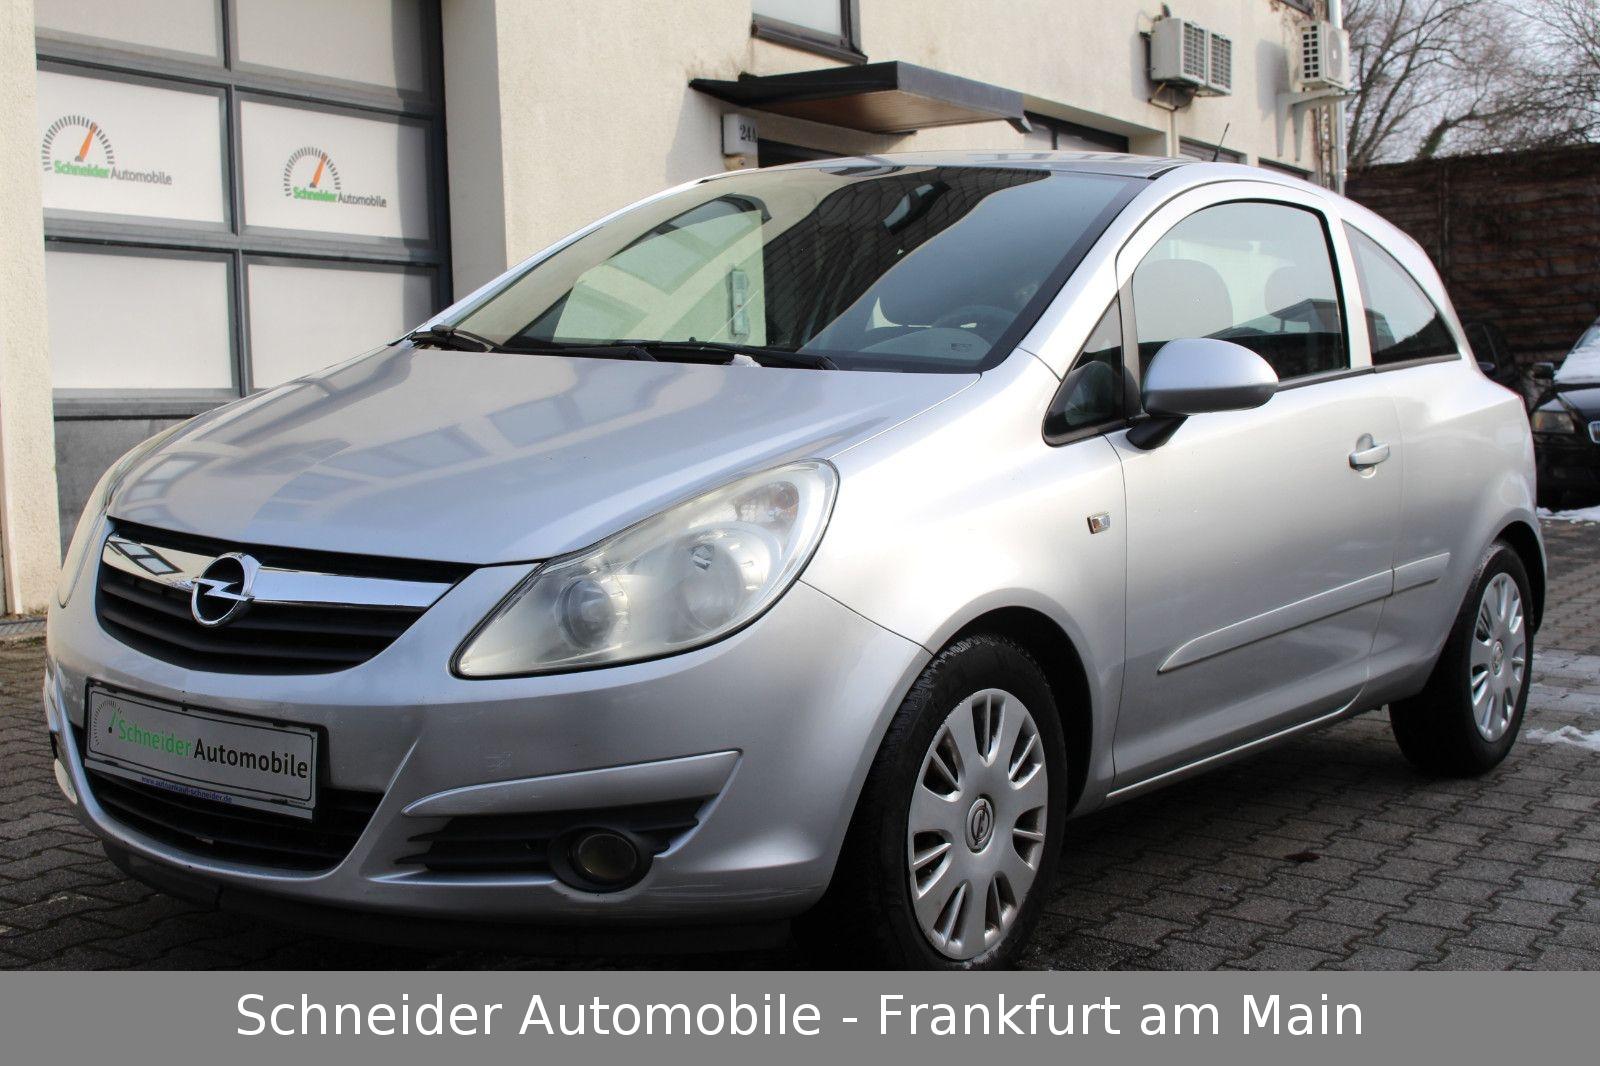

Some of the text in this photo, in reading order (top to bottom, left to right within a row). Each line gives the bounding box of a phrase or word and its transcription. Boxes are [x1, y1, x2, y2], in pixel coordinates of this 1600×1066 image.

[54, 159, 173, 186] Schneider Automobile
[293, 186, 387, 208] Schneider Automobile
[118, 719, 309, 779] Schneider Automobile
